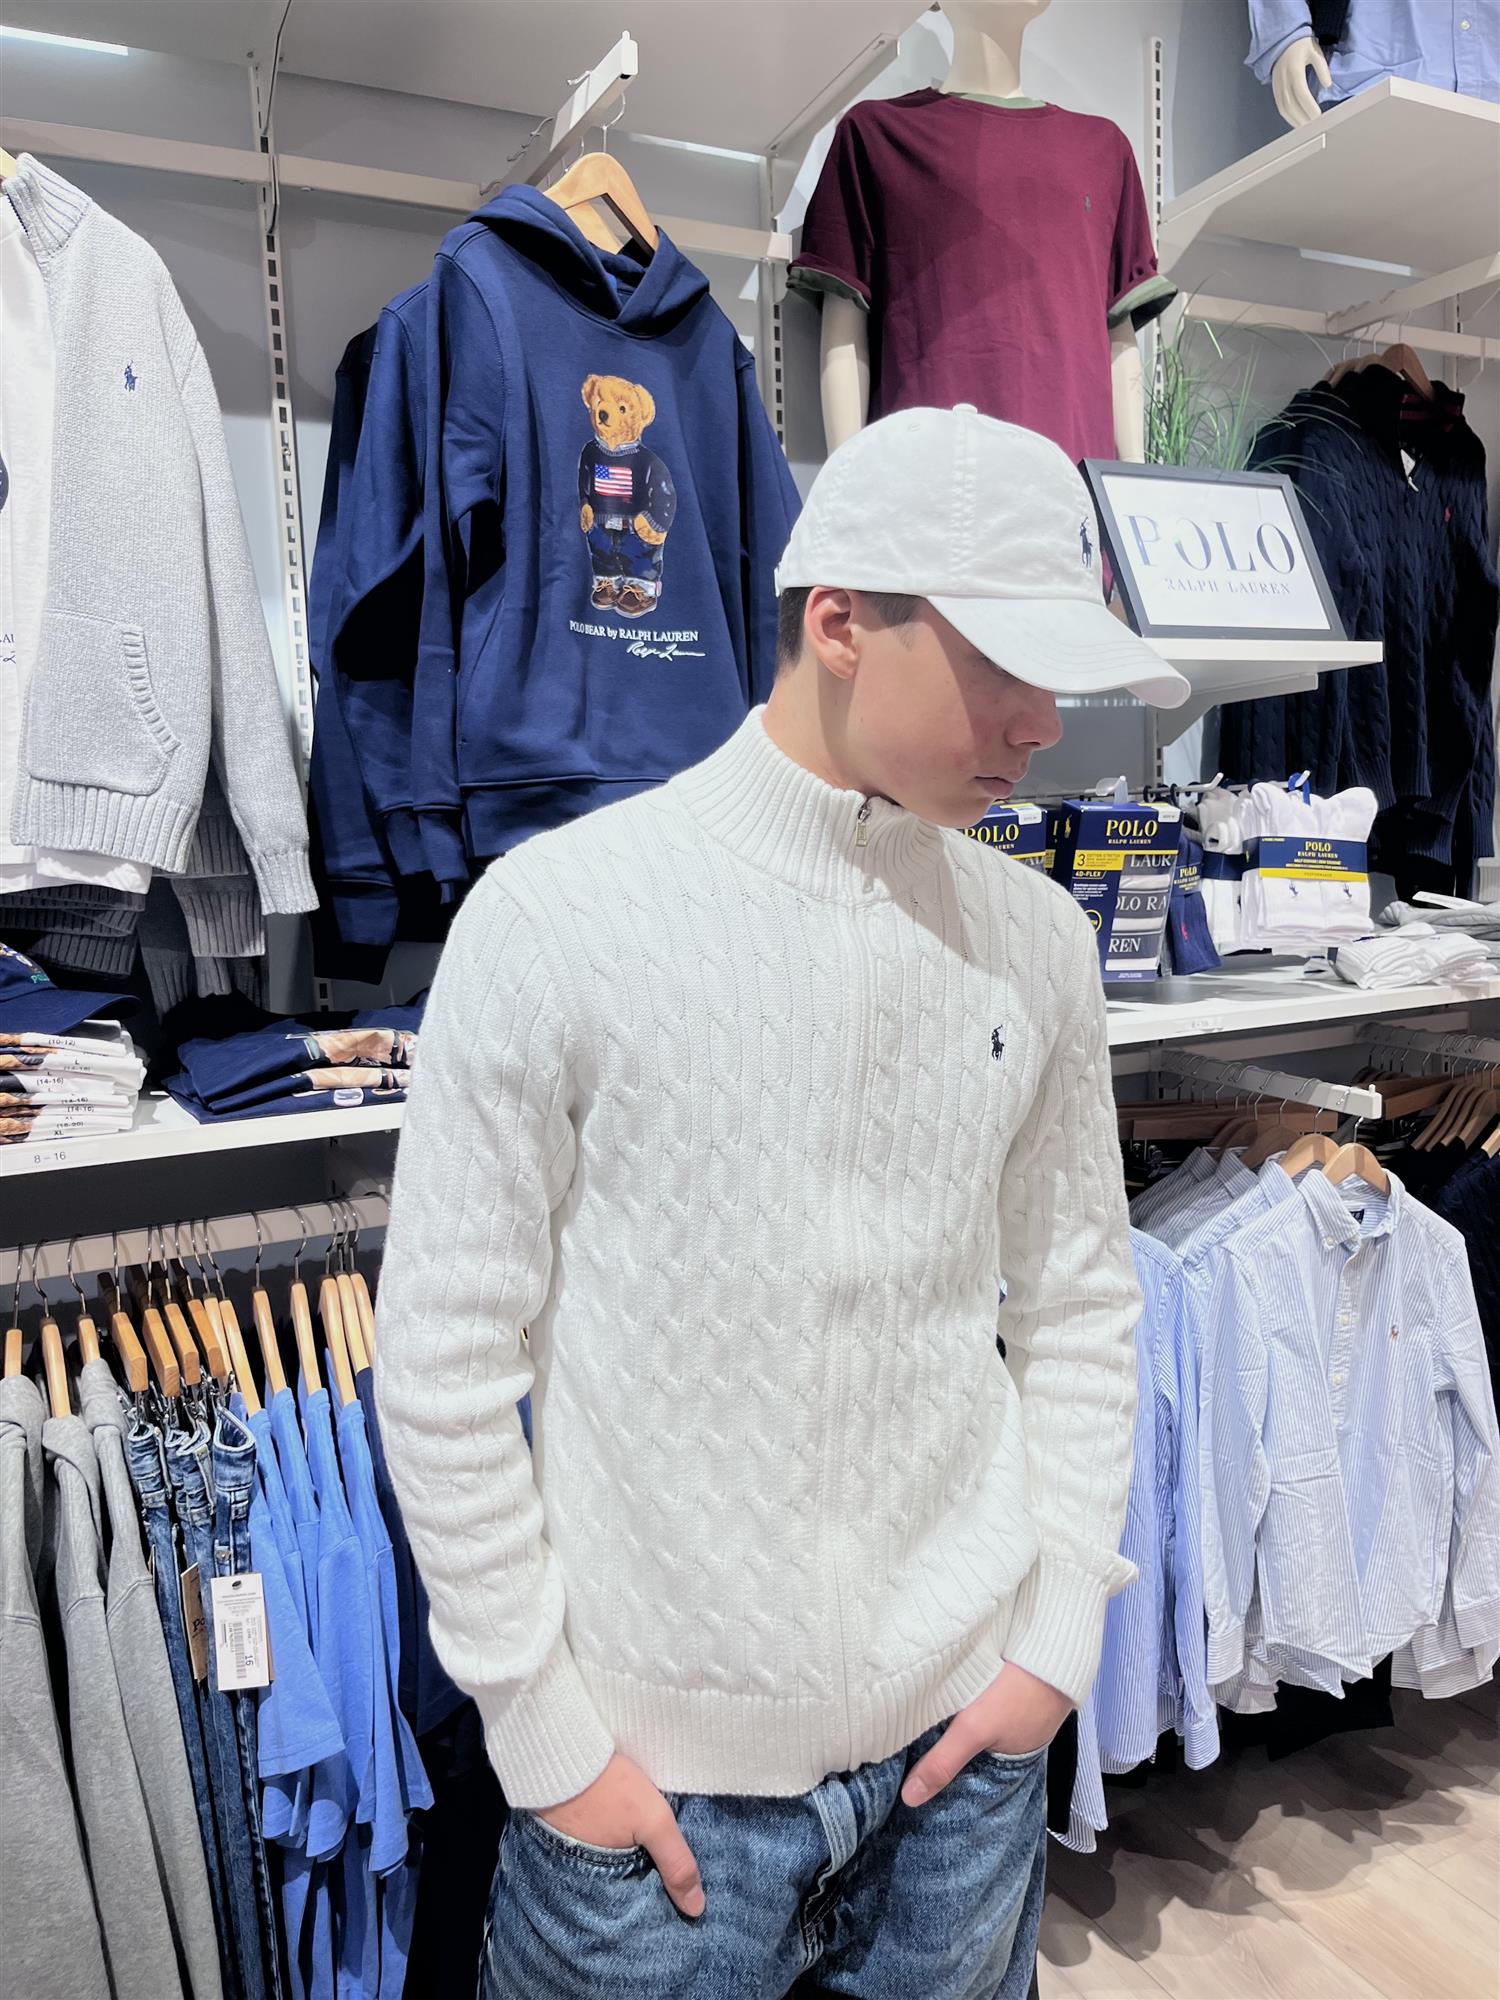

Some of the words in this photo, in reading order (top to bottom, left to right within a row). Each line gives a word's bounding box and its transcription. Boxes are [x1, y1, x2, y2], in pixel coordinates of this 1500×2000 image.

[1123, 514, 1296, 575] POLO
[1165, 577, 1219, 593] RALPH
[1228, 580, 1291, 594] LAUREN
[569, 620, 585, 634] POLO
[585, 623, 607, 637] BEAR
[607, 626, 618, 640] by
[619, 628, 651, 641] RALPH
[653, 631, 699, 642] LAUREN
[964, 823, 1020, 844] POLO
[1105, 819, 1158, 838] POLO
[1305, 840, 1331, 852] POLO
[1077, 853, 1086, 867] 3
[1180, 866, 1198, 878] POLO
[1108, 937, 1142, 953] REN
[34, 1154, 41, 1164] 8
[54, 1151, 66, 1161] 16
[244, 1654, 254, 1667] 16
